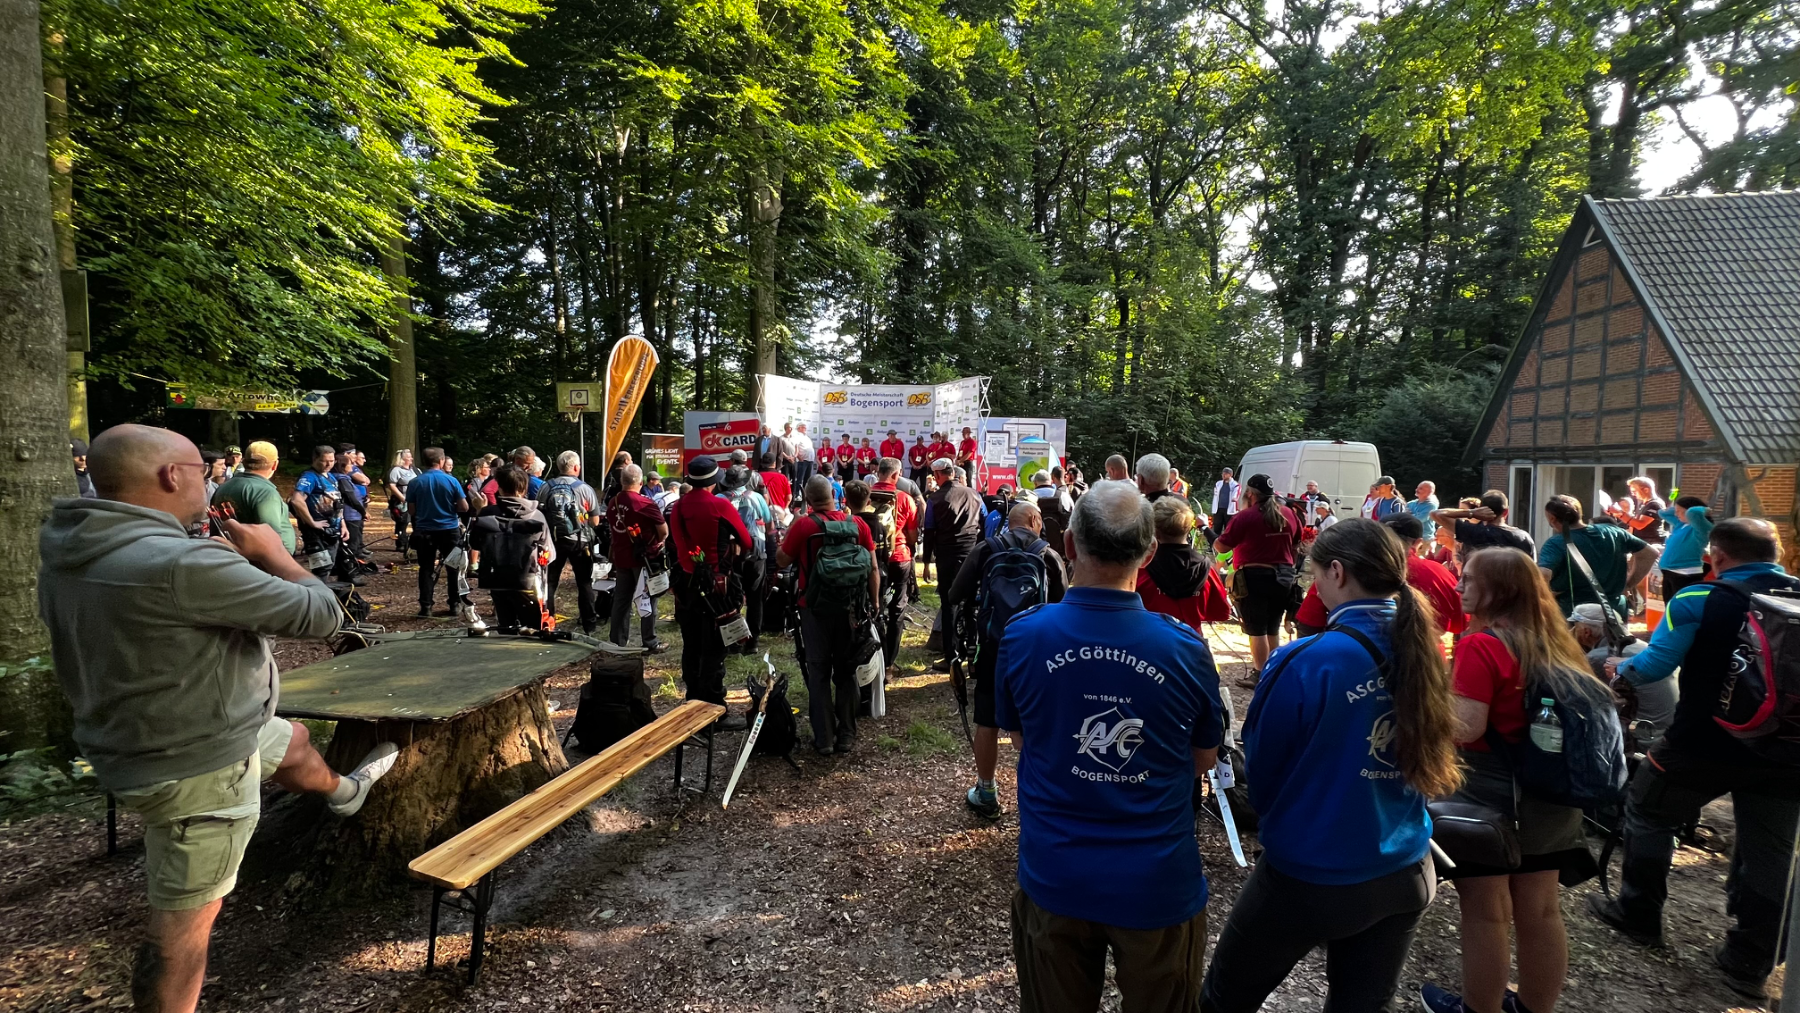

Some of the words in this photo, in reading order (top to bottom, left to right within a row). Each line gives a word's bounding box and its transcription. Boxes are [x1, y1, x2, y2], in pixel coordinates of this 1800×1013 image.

[850, 398, 904, 409] Bogensport
[723, 434, 757, 446] CARD
[1046, 649, 1076, 674] ASC
[1079, 646, 1165, 685] Göttingen
[1083, 693, 1098, 701] von
[1100, 694, 1118, 703] 1846
[1119, 696, 1132, 704] e.V.
[1345, 679, 1376, 704] ASC
[1071, 765, 1150, 784] BOGENSPORT
